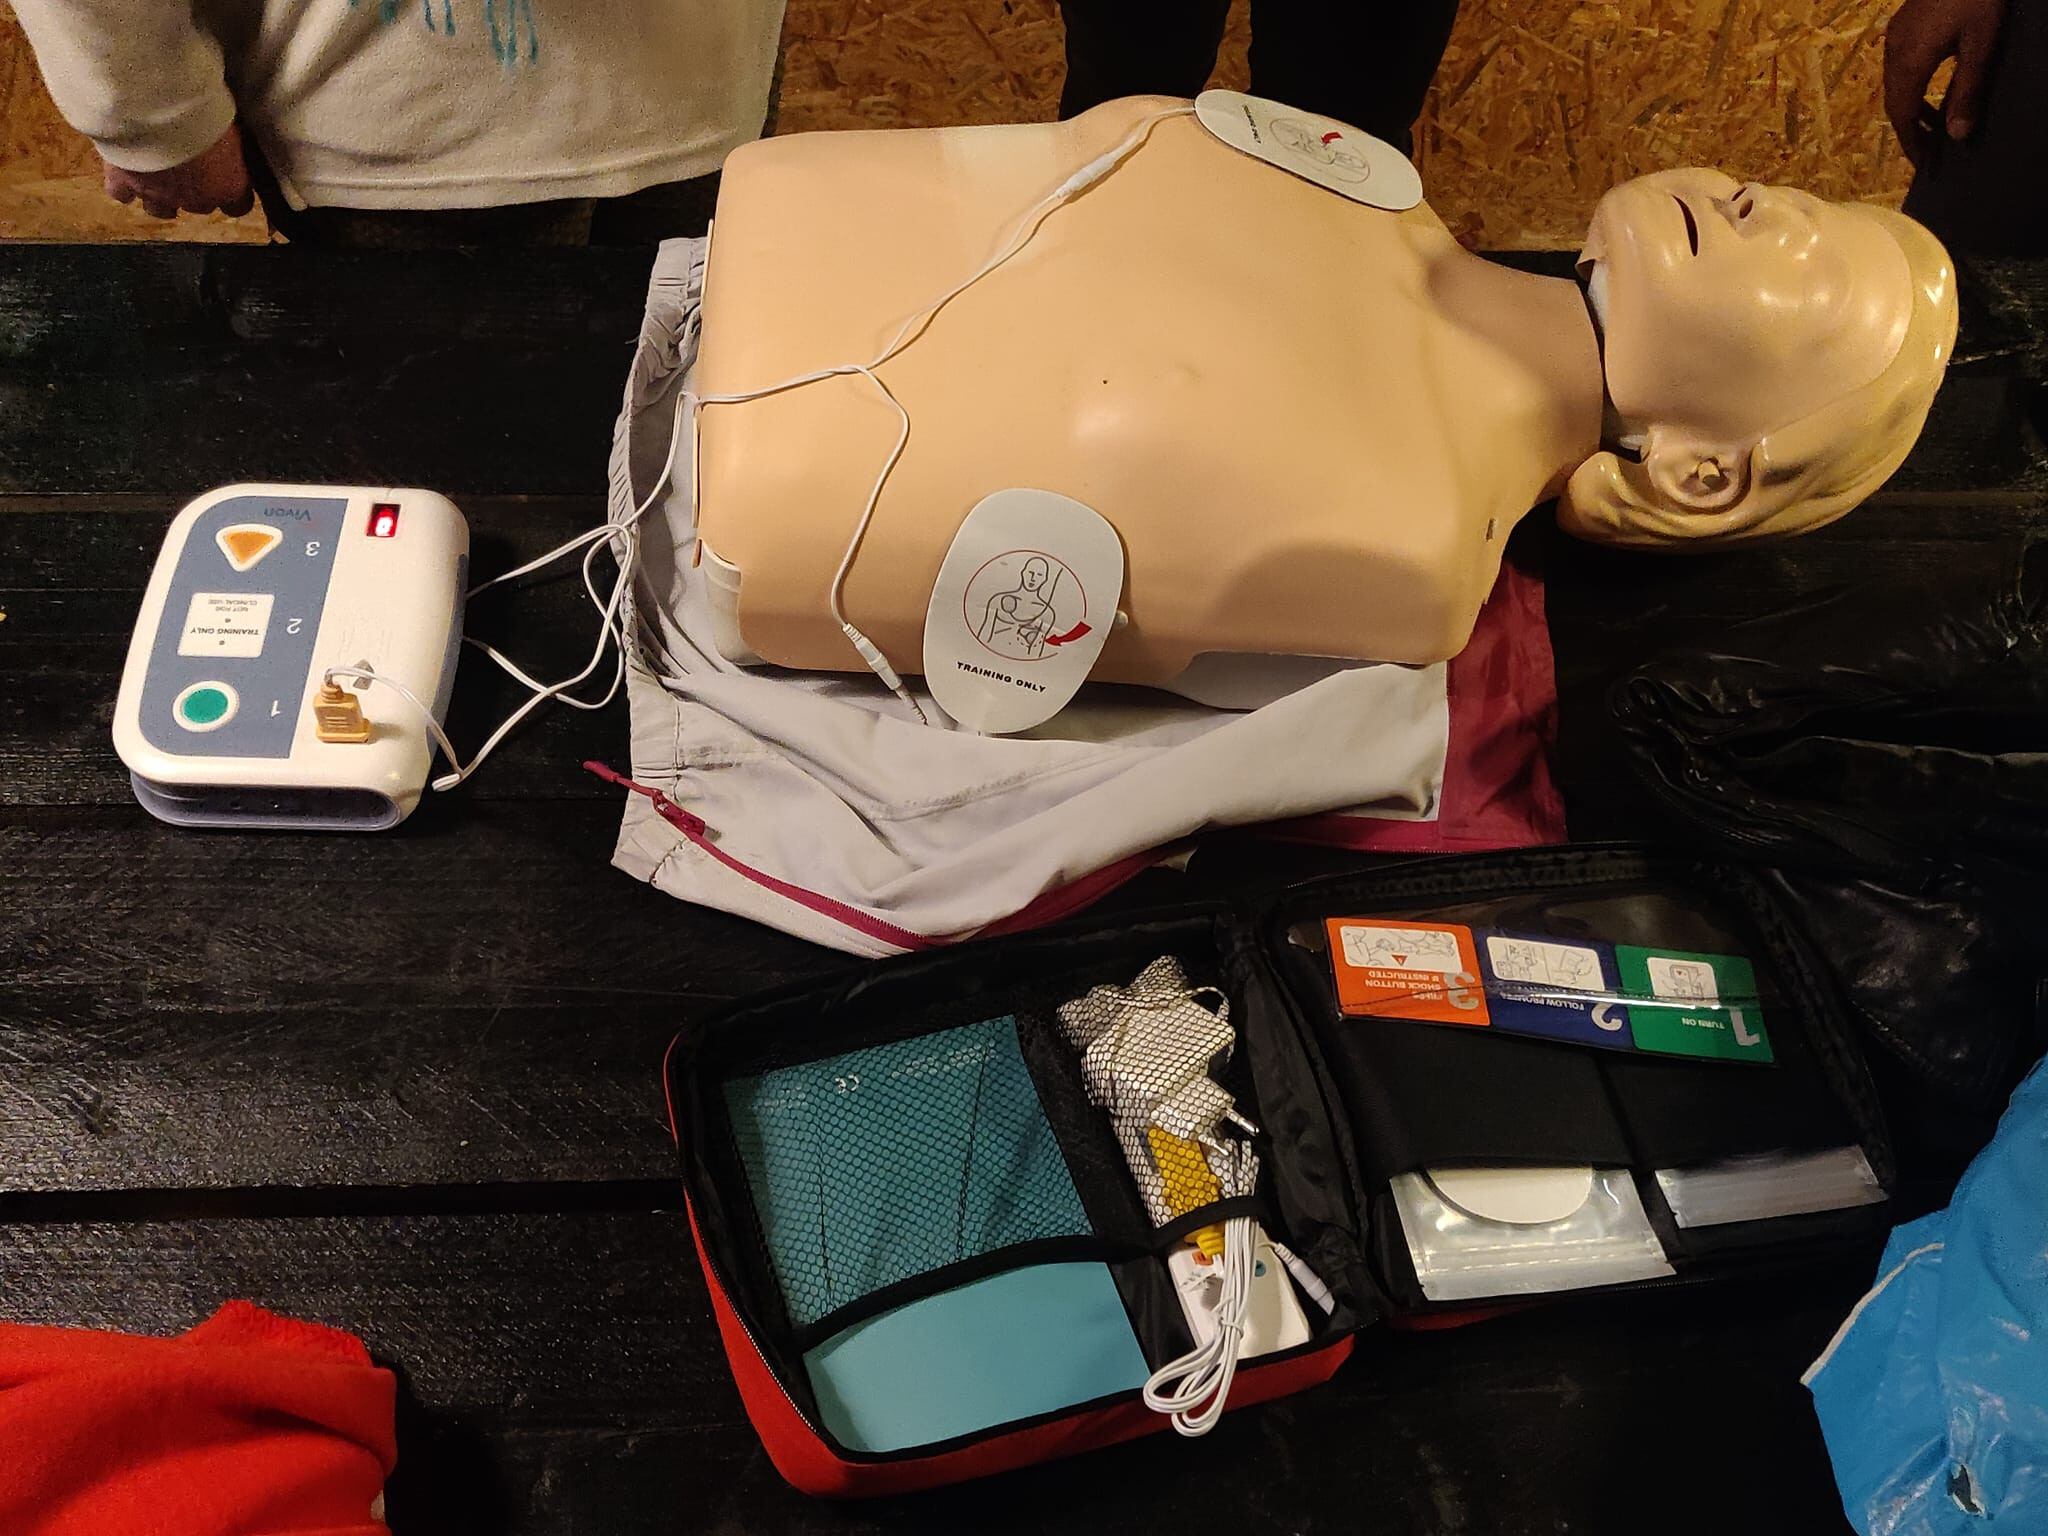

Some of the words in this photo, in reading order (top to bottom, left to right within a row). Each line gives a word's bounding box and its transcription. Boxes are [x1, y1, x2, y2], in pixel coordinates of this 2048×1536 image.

[305, 541, 321, 557] 3
[190, 627, 215, 635] ONLY
[217, 628, 260, 636] TRAINING
[286, 617, 302, 634] 2
[956, 661, 1012, 683] TRAINING
[1015, 679, 1047, 693] ONLY
[270, 700, 280, 717] 1
[1368, 970, 1430, 981] INSTRUCTED
[1365, 979, 1407, 989] BUTTON
[1407, 982, 1442, 991] SHOCK
[1443, 971, 1479, 1010] 3
[1545, 998, 1586, 1011] FOLLOW
[1591, 990, 1623, 1031] 2
[1681, 1017, 1697, 1027] ON
[1698, 1019, 1725, 1030] TURN
[1729, 1006, 1761, 1046] 1
